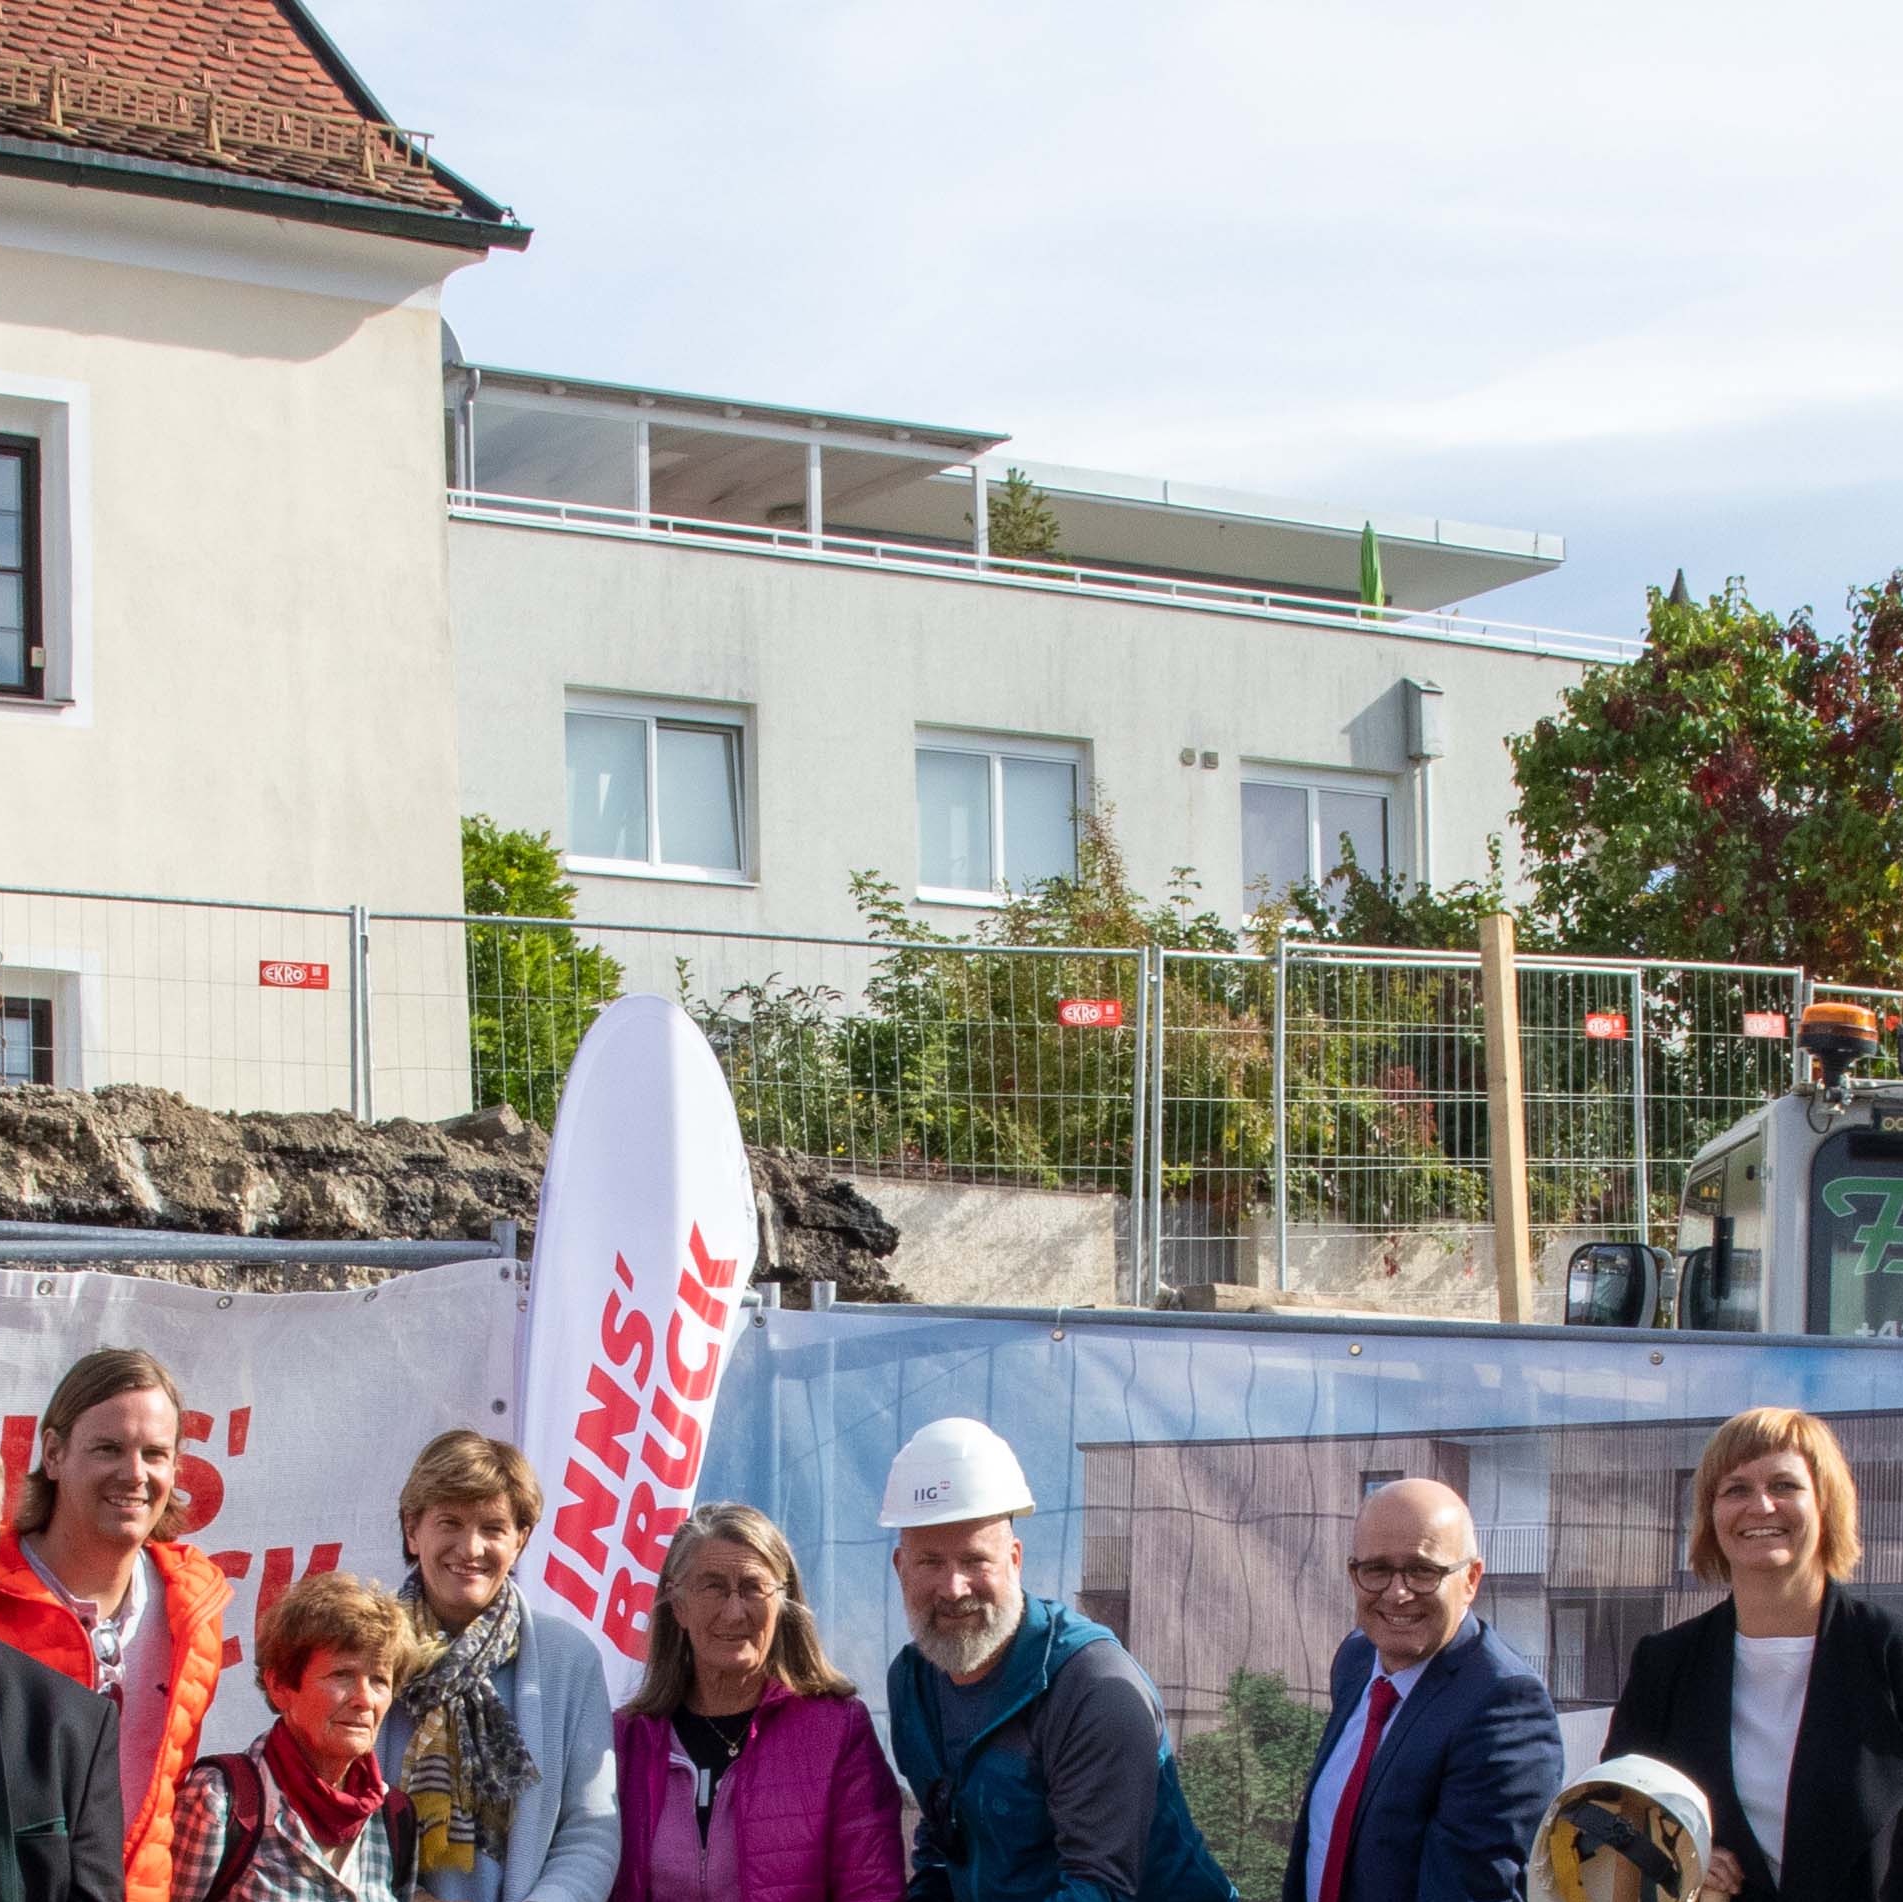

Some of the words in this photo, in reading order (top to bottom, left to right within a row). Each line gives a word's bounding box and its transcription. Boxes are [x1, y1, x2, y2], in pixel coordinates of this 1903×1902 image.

[264, 965, 304, 983] EKRO
[1064, 1005, 1099, 1022] EKRO
[602, 1219, 738, 1663] BRUCK
[914, 1487, 938, 1502] IIG
